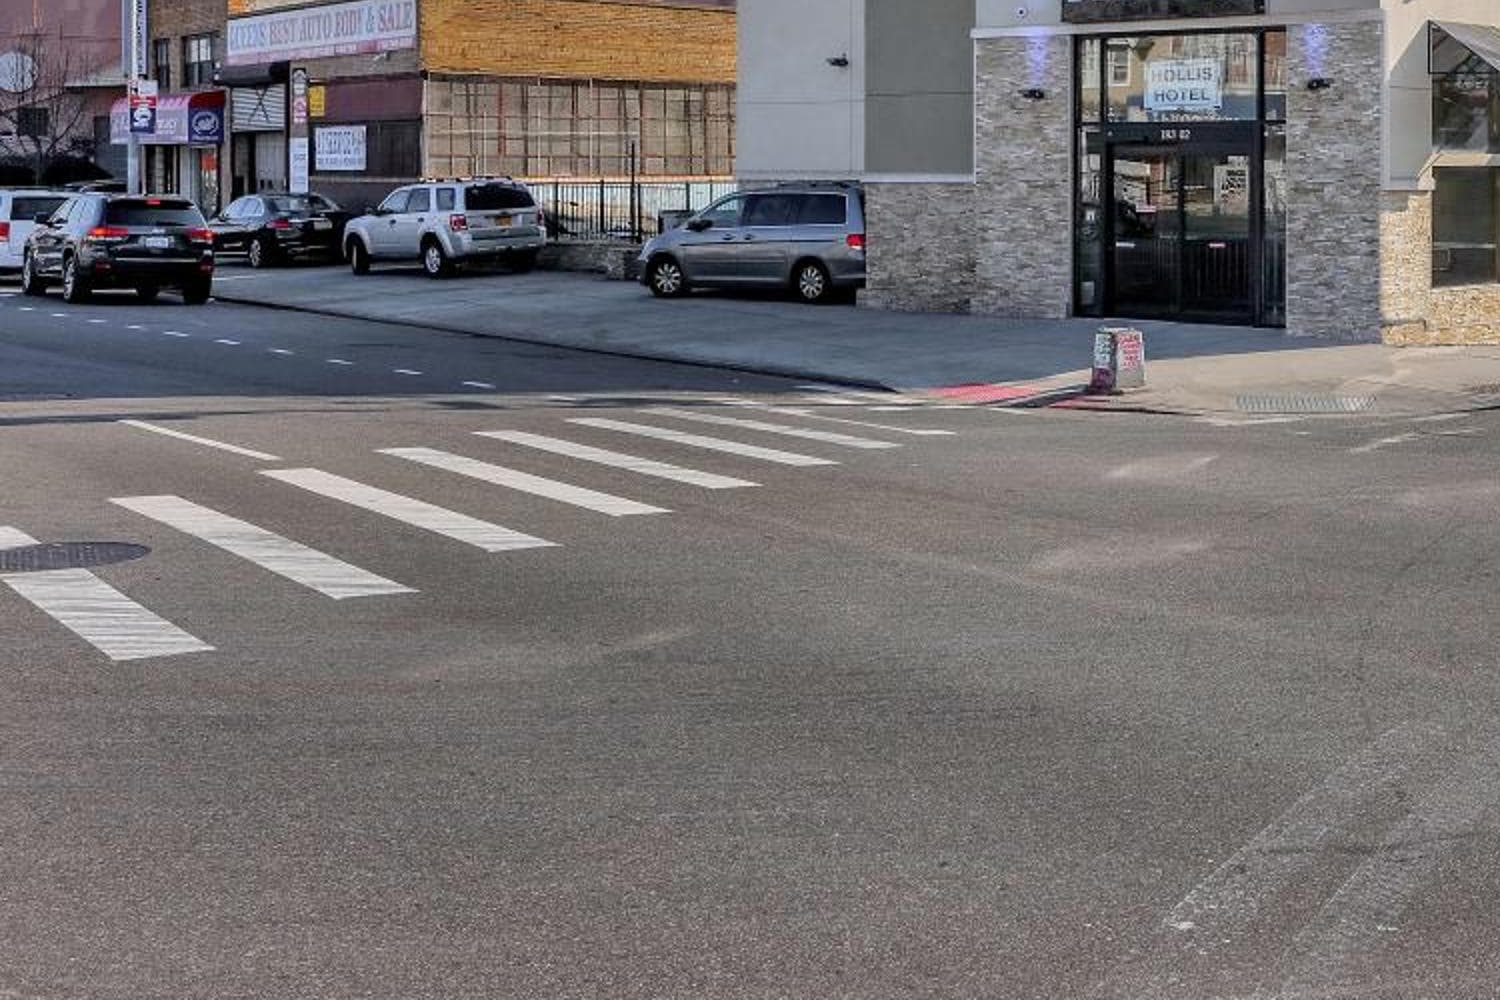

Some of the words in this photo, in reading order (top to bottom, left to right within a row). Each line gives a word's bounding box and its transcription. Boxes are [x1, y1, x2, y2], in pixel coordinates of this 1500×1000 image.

[298, 13, 333, 42] AUTO
[377, 2, 413, 32] SALE
[1151, 67, 1213, 82] HOLLIS
[1153, 87, 1211, 102] HOTEL
